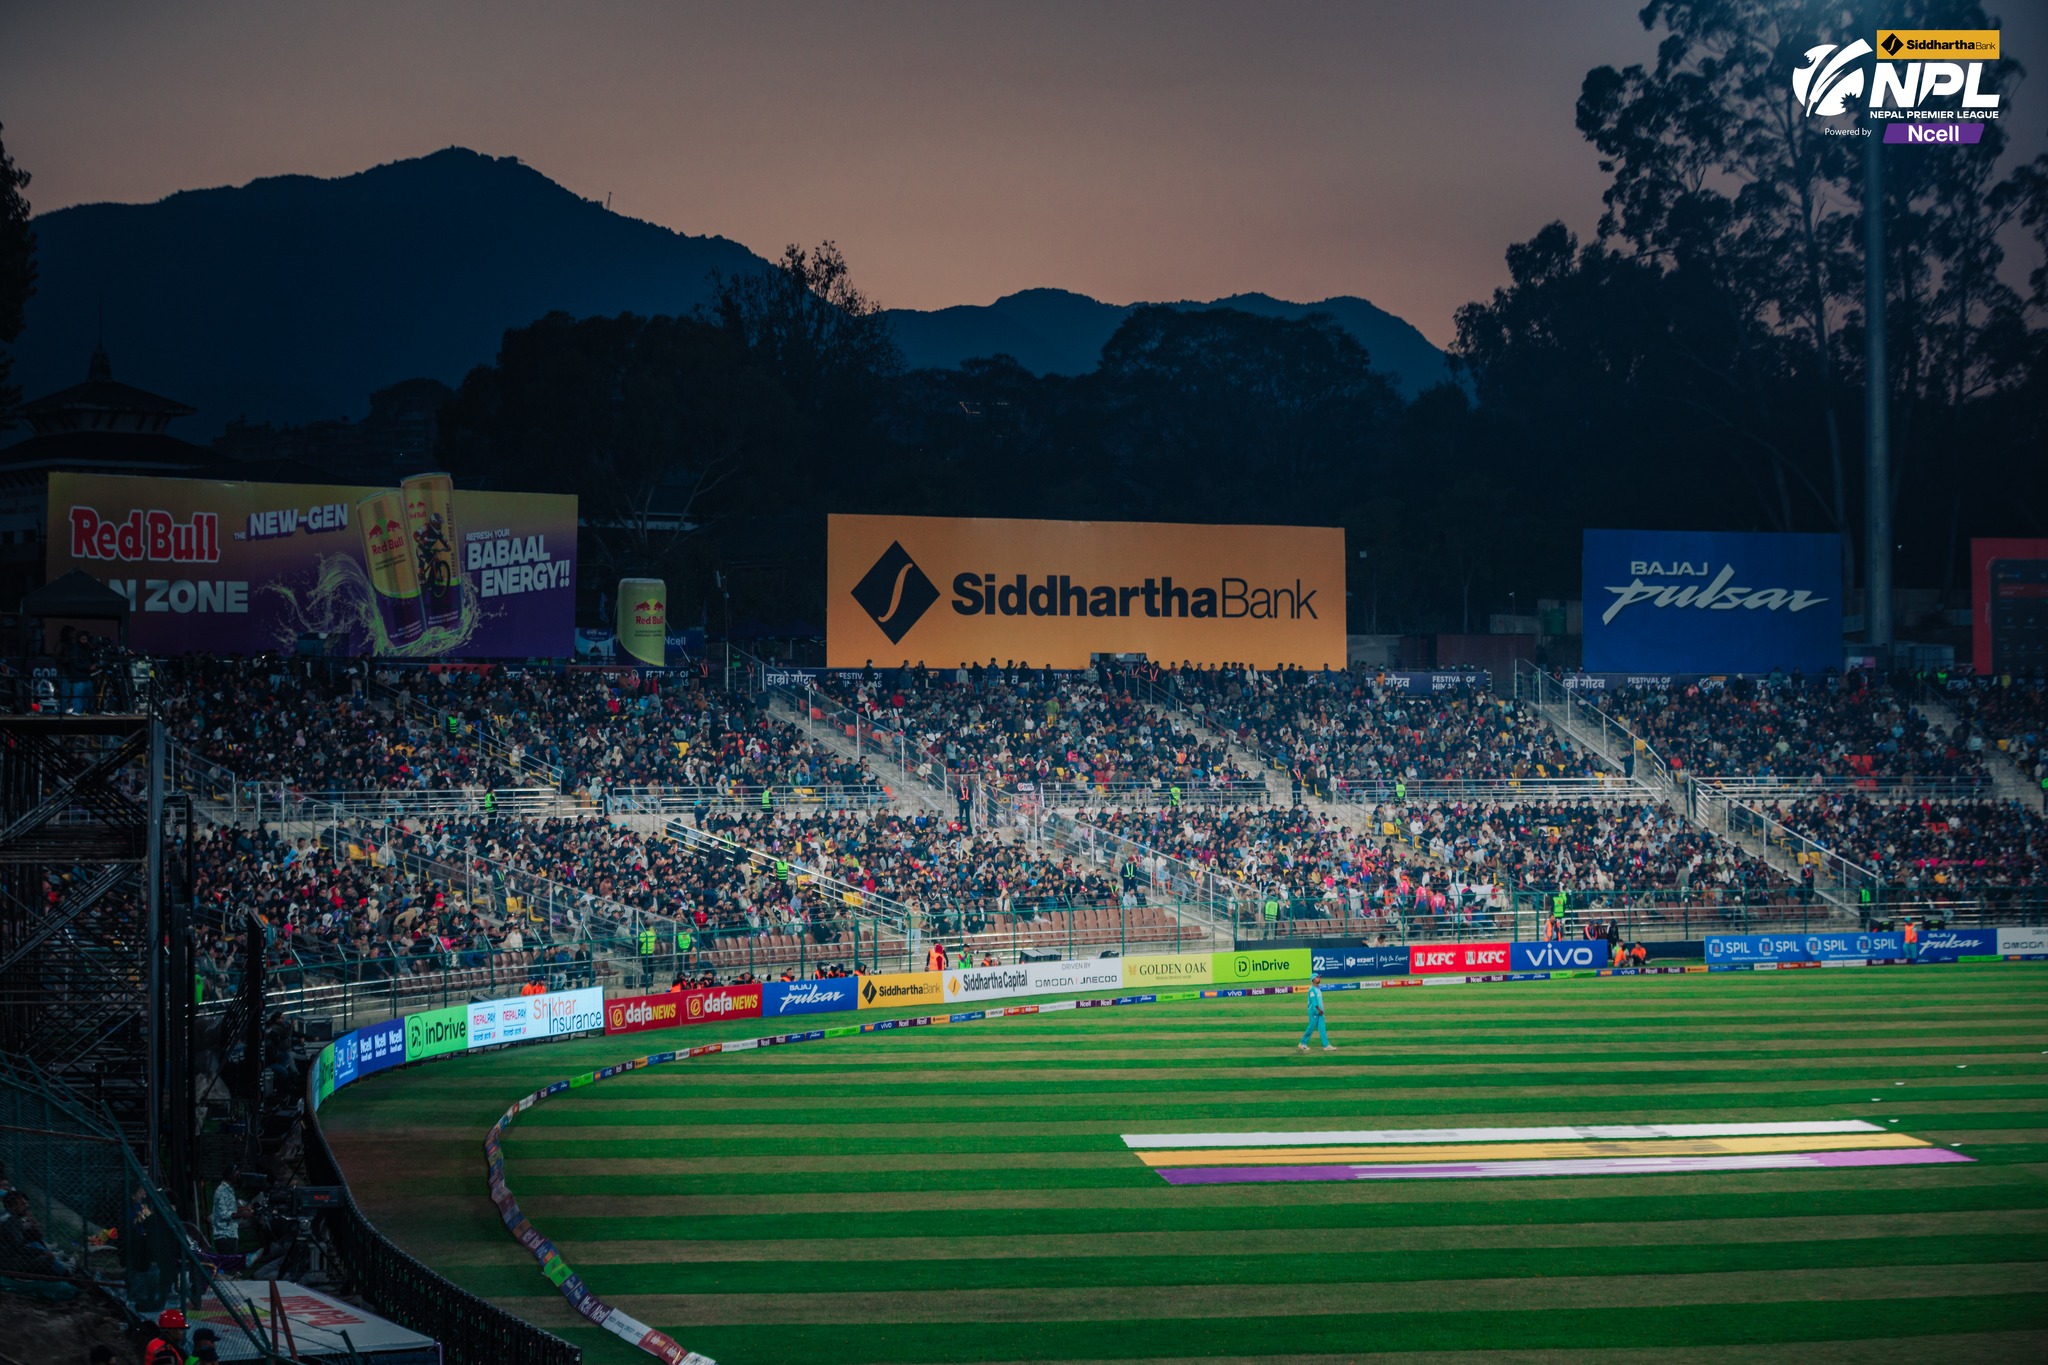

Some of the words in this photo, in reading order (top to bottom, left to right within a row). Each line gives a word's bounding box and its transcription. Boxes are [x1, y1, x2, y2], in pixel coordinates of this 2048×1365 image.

[250, 503, 348, 537] NEW-GEN
[69, 506, 145, 561] Red
[146, 510, 220, 563] Bull
[233, 532, 246, 541] THE
[465, 530, 493, 541] REFRESH
[493, 529, 510, 537] YOUR
[371, 541, 388, 556] Red
[389, 538, 404, 551] Bull
[467, 535, 550, 571] BABAAL
[1631, 561, 1708, 576] BAJAJ
[481, 560, 570, 597] ENERGY!!
[145, 579, 248, 613] ZONE
[951, 572, 1319, 620] SiddharthaBank
[1602, 562, 1830, 626] pulsar
[635, 616, 651, 625] Red
[652, 616, 664, 625] Bull
[1580, 675, 1605, 689] गौरव
[1725, 942, 1750, 954] SPIL
[1775, 941, 1800, 953] SPIL
[1823, 940, 1848, 951] SPIL
[1873, 938, 1898, 950] SPIL
[1918, 934, 1983, 955] pulsar
[1313, 956, 1326, 971] 22
[1426, 952, 1455, 966] KFC
[1476, 951, 1506, 964] KFC
[1525, 943, 1593, 967] vivo
[1139, 963, 1181, 976] GOLDEN
[1184, 962, 1207, 974] OAK
[1252, 959, 1290, 972] inDrive
[779, 984, 846, 1013] pulsar
[879, 982, 942, 997] SiddharthaBank
[534, 998, 577, 1020] Shikhar
[703, 992, 758, 1015] dafaNEWS
[549, 1003, 602, 1034] Insurance
[626, 1002, 677, 1026] dafaNEWS
[425, 1018, 466, 1044] inDrive
